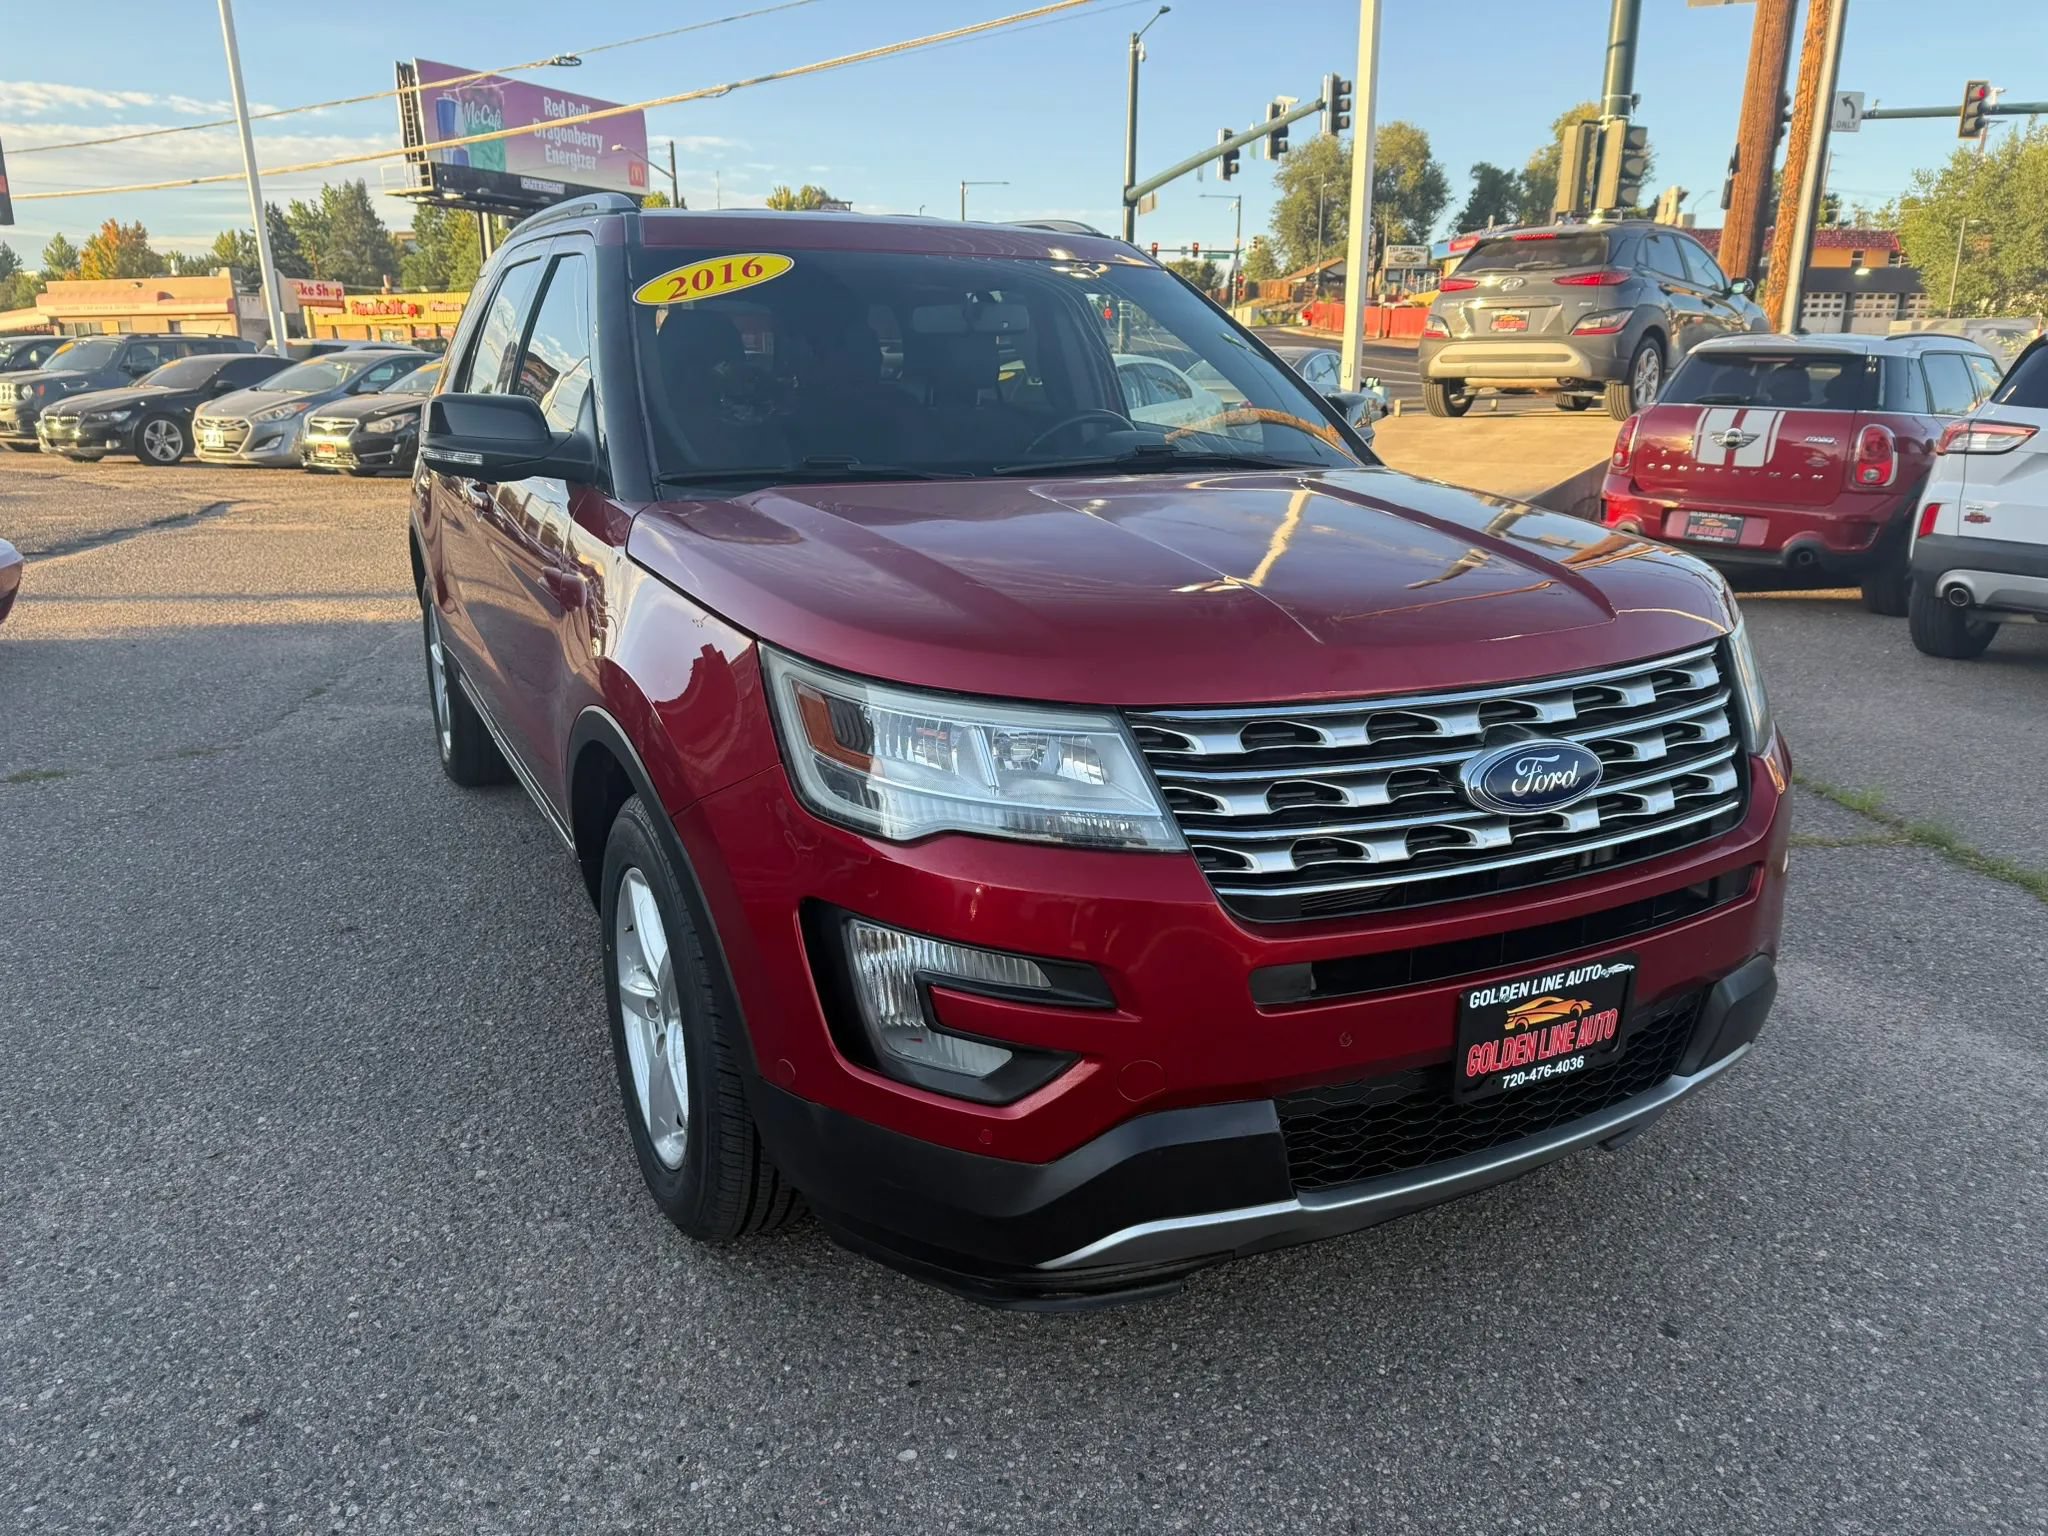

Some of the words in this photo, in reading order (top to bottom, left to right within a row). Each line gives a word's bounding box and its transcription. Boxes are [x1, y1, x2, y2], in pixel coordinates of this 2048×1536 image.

[543, 96, 566, 118] Red
[567, 101, 591, 124] Bull
[1836, 120, 1857, 129] ONLY
[532, 117, 603, 154] Dragonberry
[545, 144, 597, 172] Energizer
[316, 283, 342, 301] Shop
[666, 256, 763, 300] 2016
[351, 298, 387, 316] Smoke
[388, 298, 417, 318] Shop
[1647, 462, 1824, 479] COUNTRYMAN
[1511, 754, 1581, 797] Ford
[1469, 981, 1531, 1009] GOLDEN
[1531, 973, 1565, 996] LINE
[1565, 964, 1602, 987] AUTO
[1466, 1028, 1539, 1077] GOLDEN
[1538, 1019, 1577, 1061] LINE
[1575, 1008, 1618, 1050] AUTO
[1502, 1055, 1585, 1089] 720-476-4036
